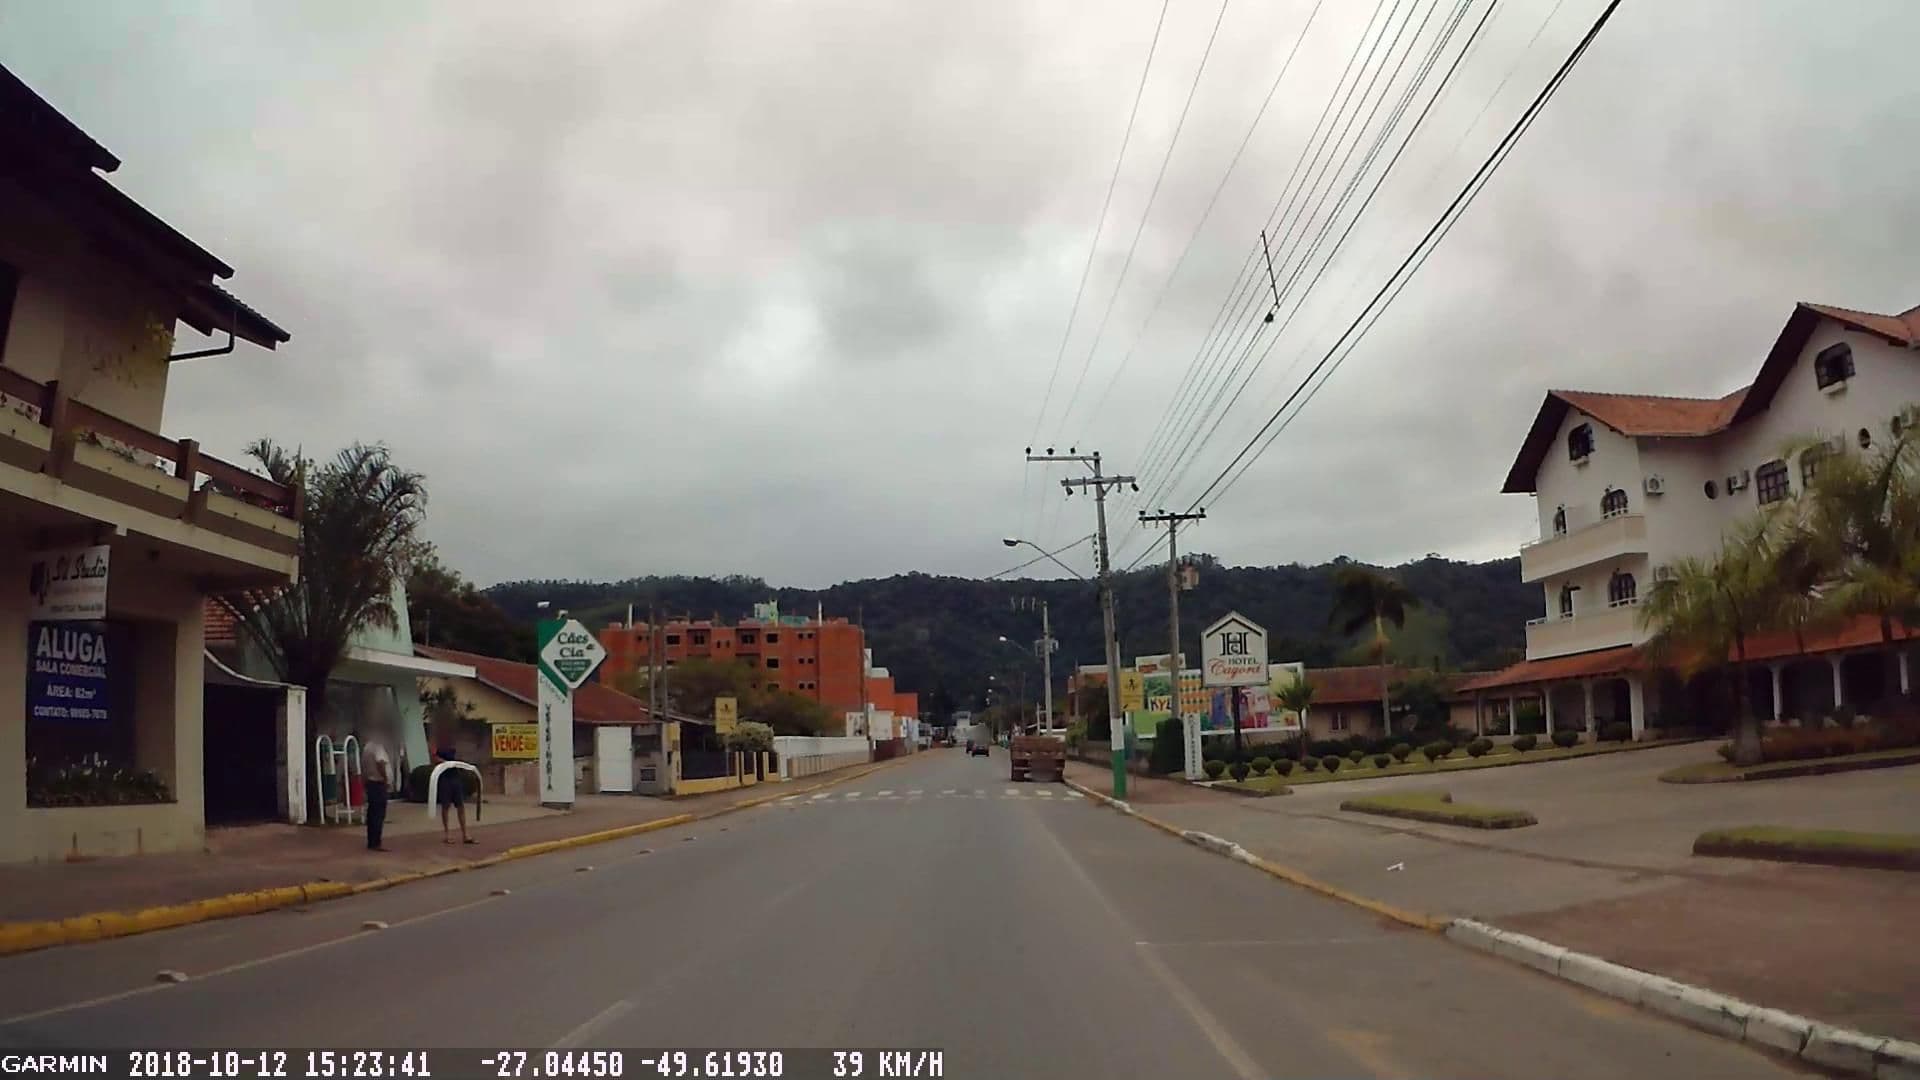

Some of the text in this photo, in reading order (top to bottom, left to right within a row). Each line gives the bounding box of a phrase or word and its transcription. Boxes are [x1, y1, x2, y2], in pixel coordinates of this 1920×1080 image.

[71, 553, 107, 579] Studio
[36, 626, 107, 664] ALUGA
[560, 646, 584, 657] Cia
[36, 660, 107, 679] SALA COMERCIAL
[1228, 657, 1258, 665] HOTEL
[496, 735, 524, 751] VENDE
